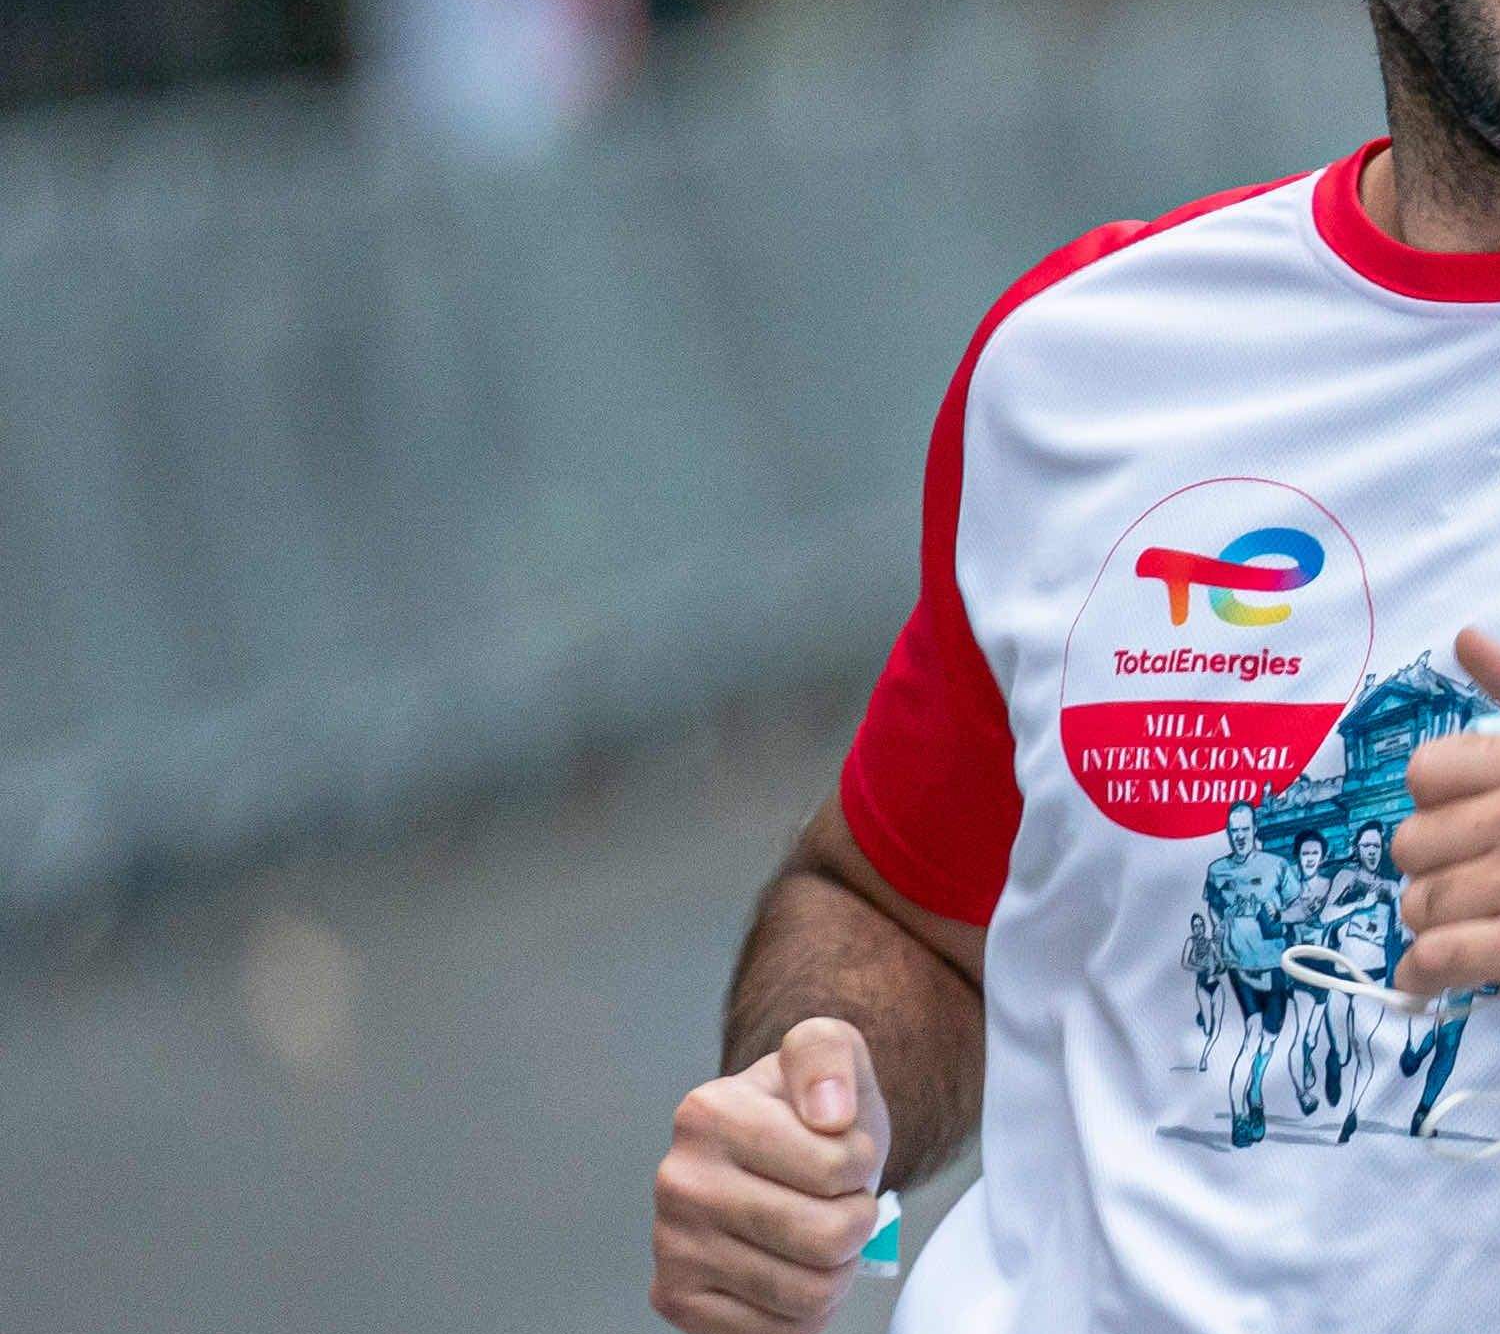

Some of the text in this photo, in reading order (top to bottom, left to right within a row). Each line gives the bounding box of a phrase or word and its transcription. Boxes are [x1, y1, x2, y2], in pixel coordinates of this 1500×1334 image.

[1114, 648, 1301, 681] TotalEnergies
[1145, 714, 1232, 738] MILLA
[1106, 779, 1257, 804] DE MADRID
